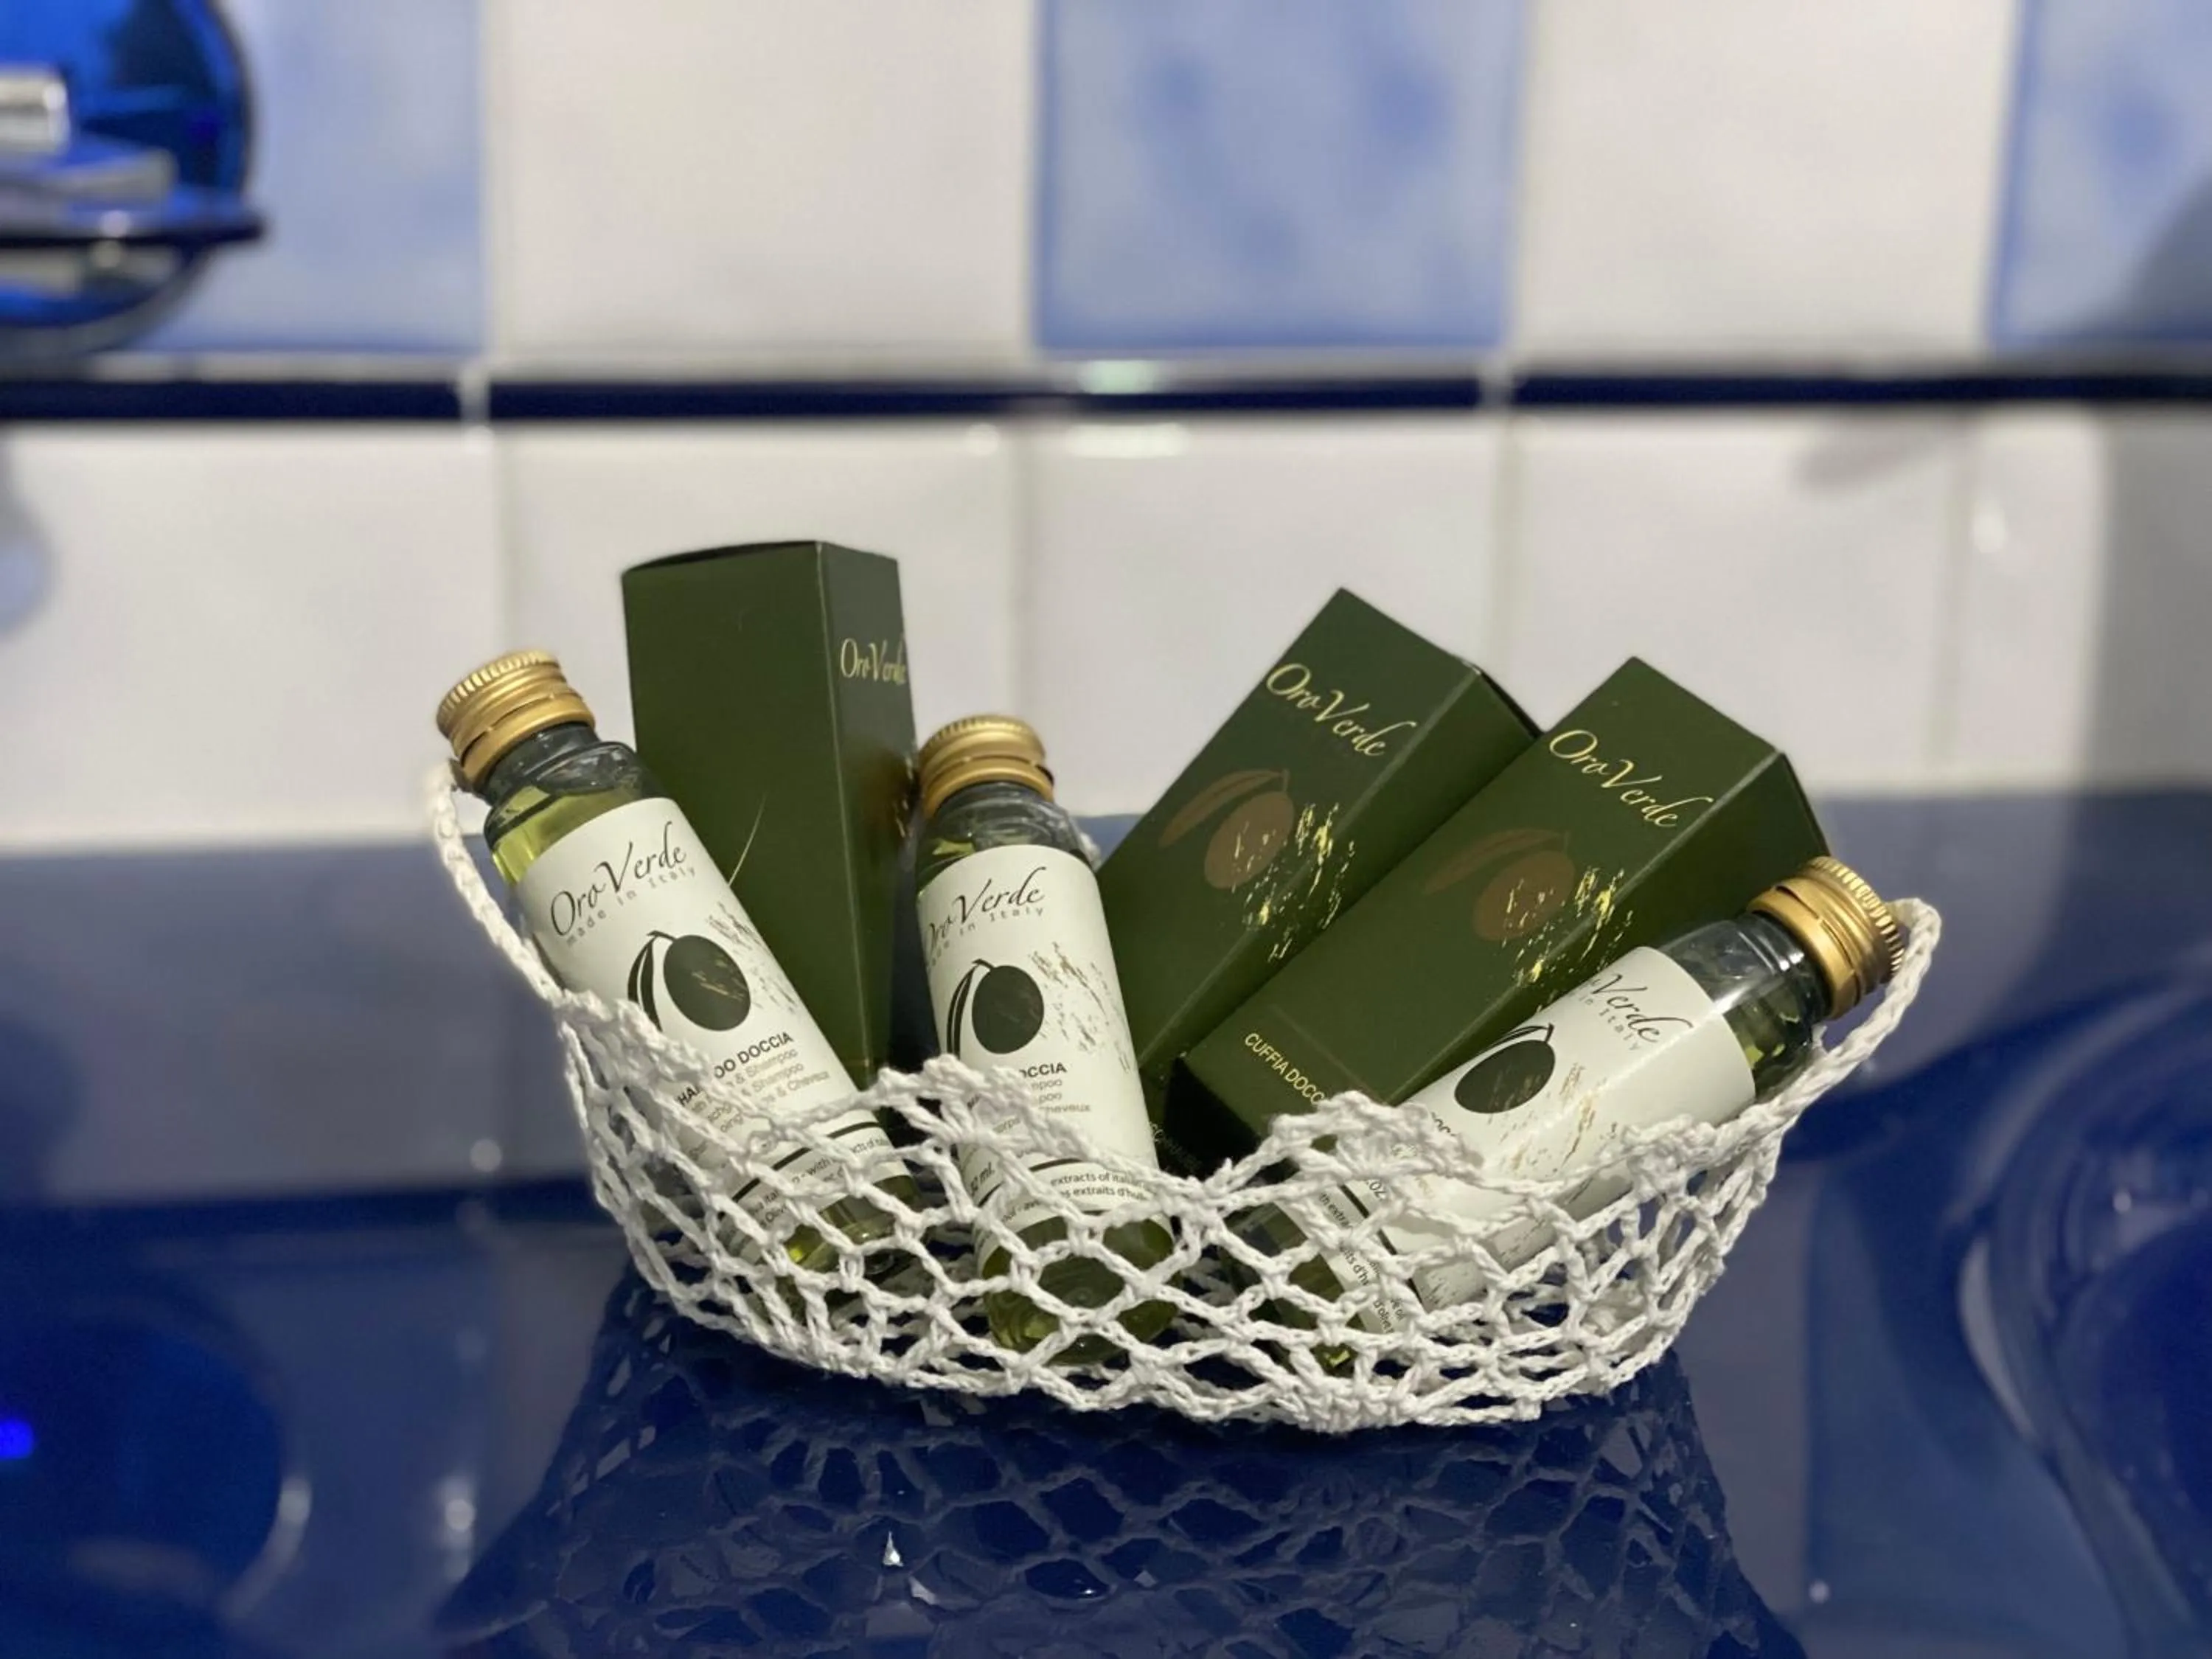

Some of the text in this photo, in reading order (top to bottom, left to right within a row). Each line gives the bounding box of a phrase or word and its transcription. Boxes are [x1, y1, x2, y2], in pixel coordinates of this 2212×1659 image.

[1266, 664, 1416, 757] Oro Verde
[1549, 729, 1713, 827] Oro Verde
[550, 820, 686, 936] Oro Verde
[952, 866, 1046, 924] Verde
[1590, 973, 1694, 1043] Verde
[737, 1032, 794, 1064] DOCCIA
[1245, 1032, 1325, 1105] CUFFIA DOCC
